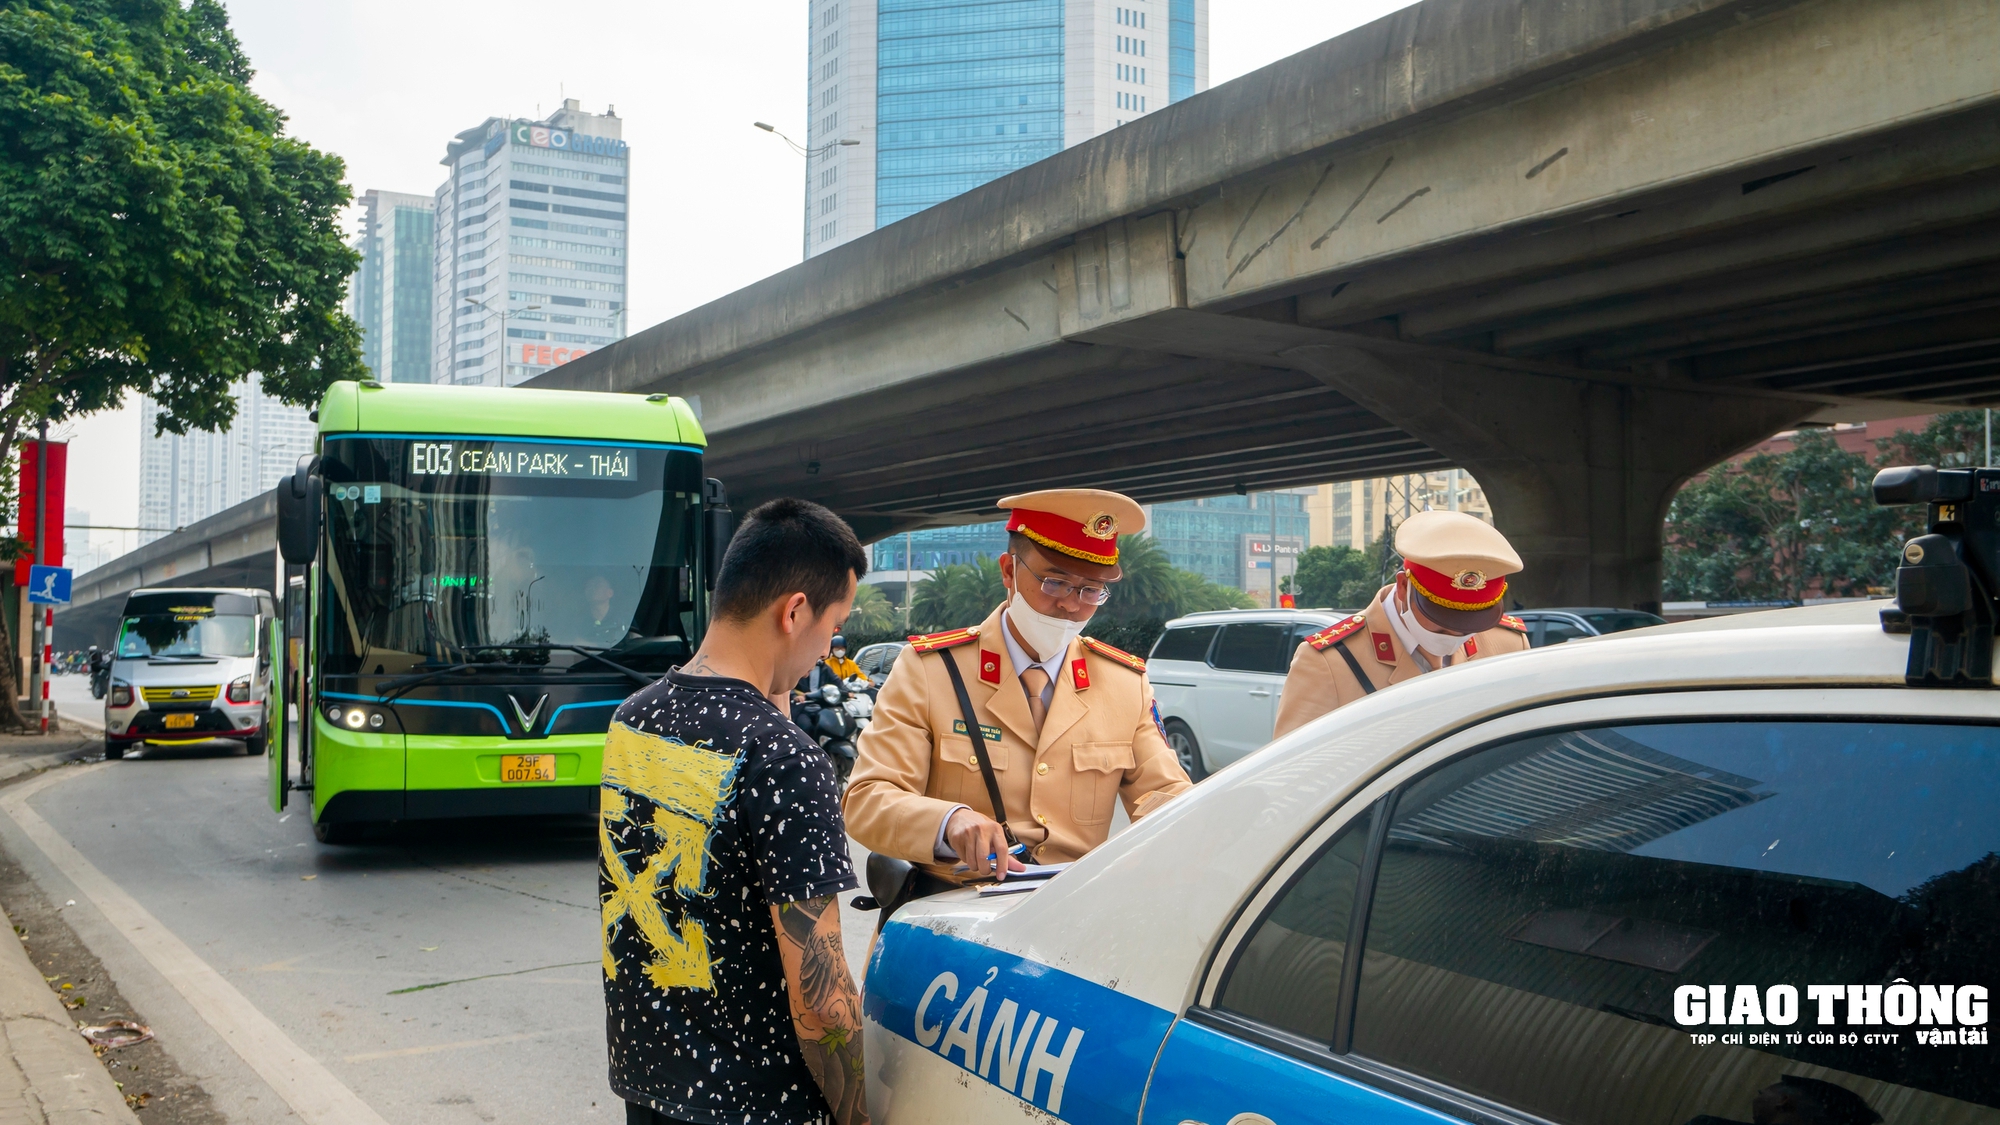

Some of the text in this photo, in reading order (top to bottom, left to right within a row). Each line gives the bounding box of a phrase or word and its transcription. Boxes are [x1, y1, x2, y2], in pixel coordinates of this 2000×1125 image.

[571, 133, 627, 157] GROUP
[522, 343, 590, 367] FEC
[413, 443, 453, 475] E03
[460, 450, 512, 473] CEAN
[518, 452, 569, 475] PARK
[590, 450, 629, 477] THÁI
[517, 756, 540, 768] 29F
[507, 768, 549, 781] 007.94
[915, 966, 1085, 1115] CẢNH
